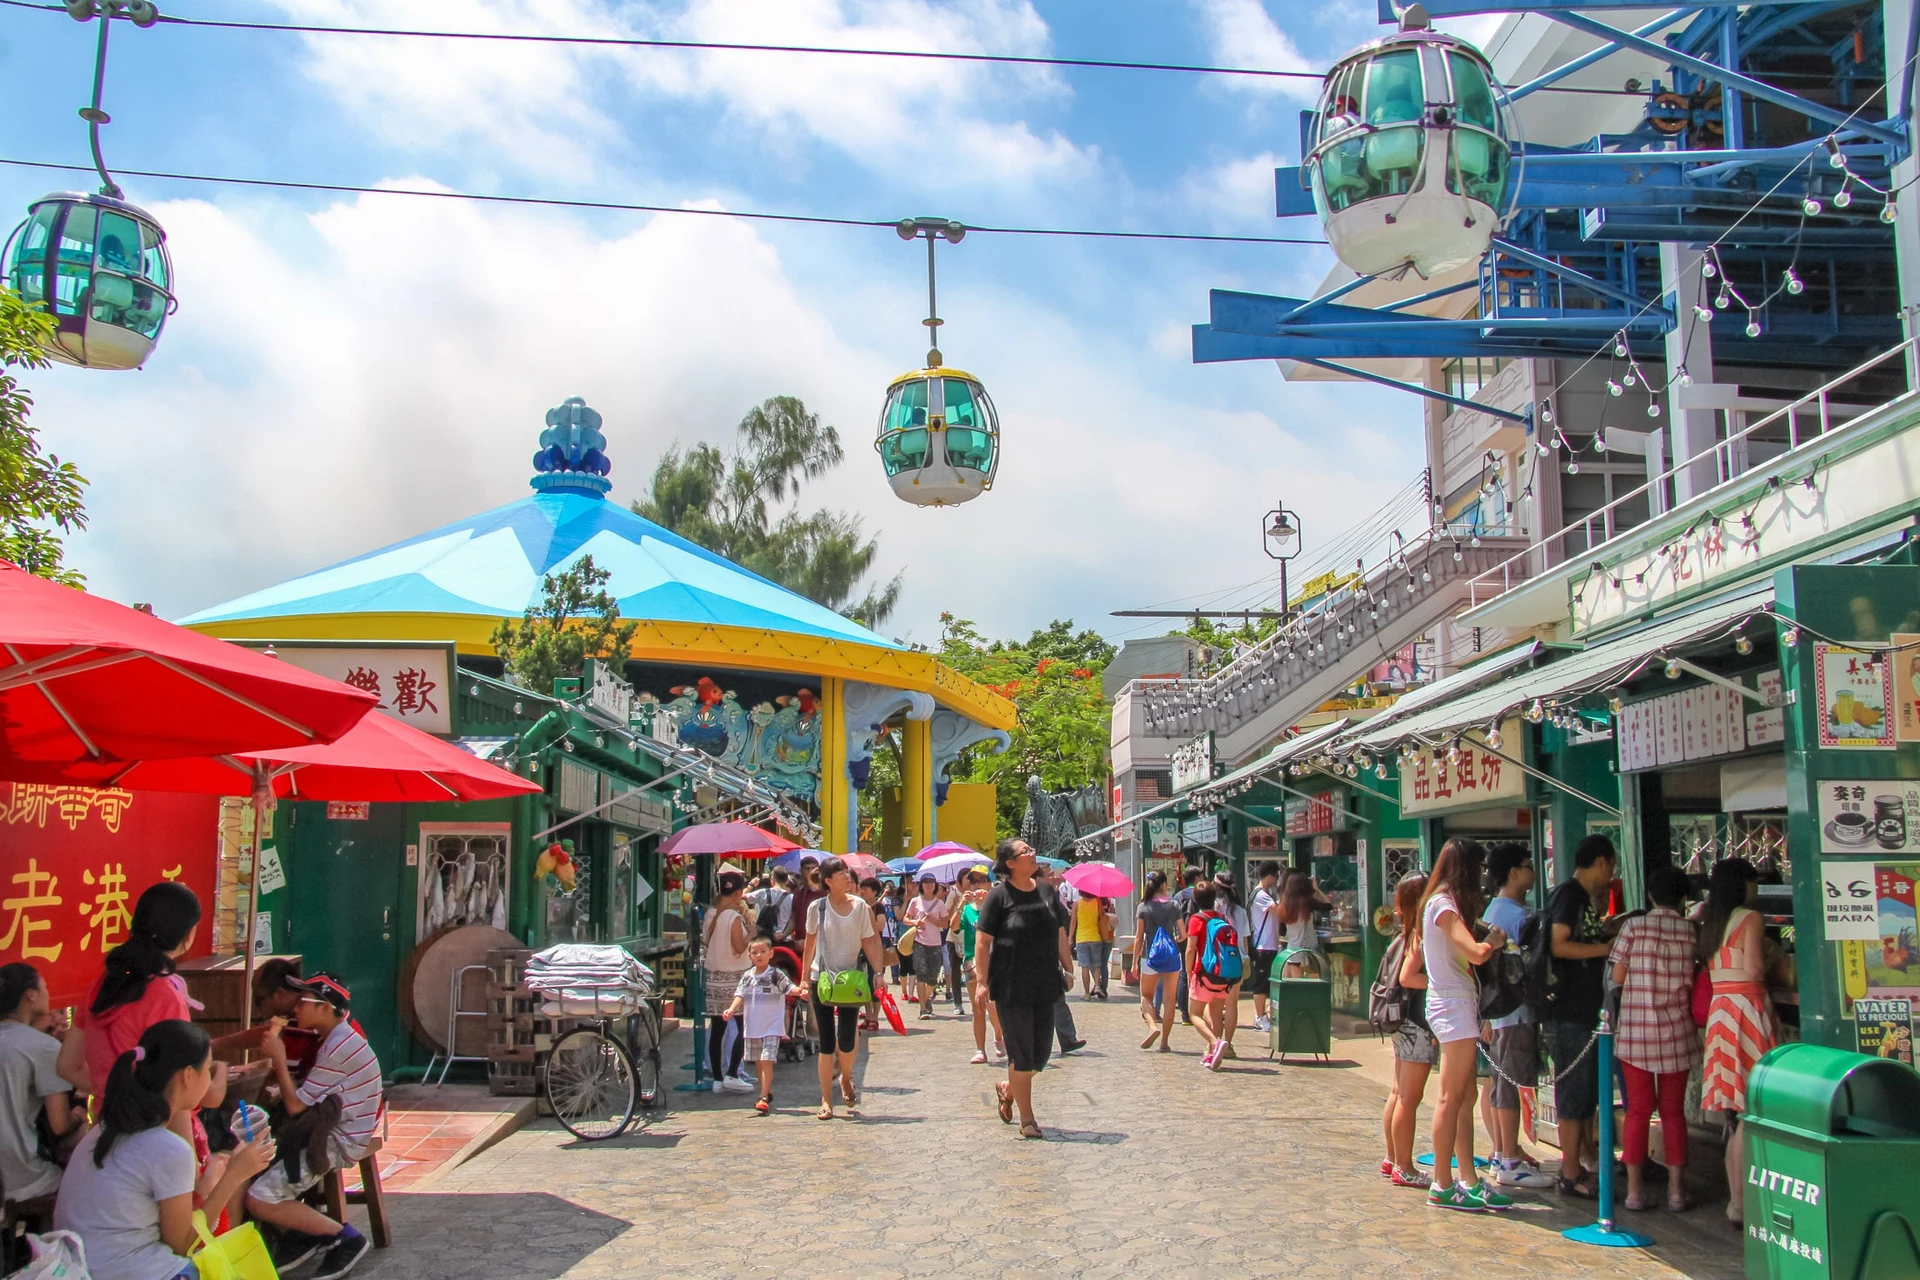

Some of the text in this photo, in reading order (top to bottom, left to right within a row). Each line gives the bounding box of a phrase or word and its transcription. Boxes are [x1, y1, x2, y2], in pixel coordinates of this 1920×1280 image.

[1855, 1002, 1907, 1013] WATER
[1868, 1013, 1908, 1021] PRECIOUS
[1748, 1165, 1821, 1206] LITTER
